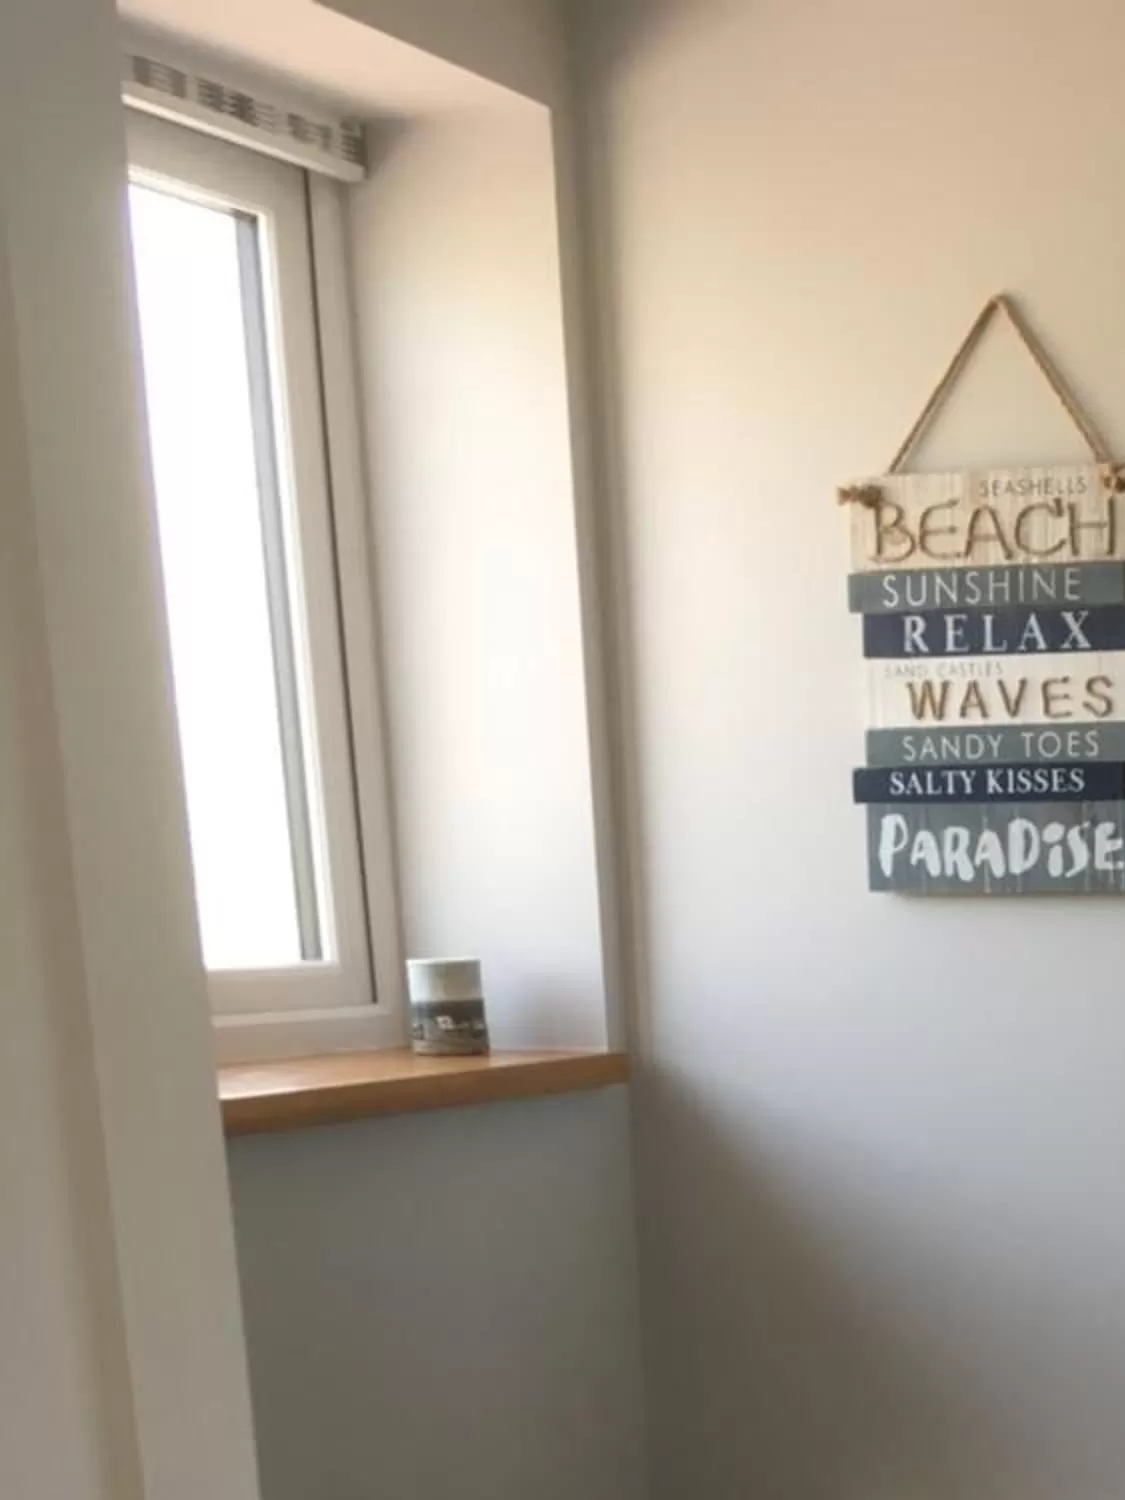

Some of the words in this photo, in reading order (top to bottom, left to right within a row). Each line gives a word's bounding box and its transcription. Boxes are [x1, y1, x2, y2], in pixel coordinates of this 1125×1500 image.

[979, 476, 1087, 496] SEASHELLS
[868, 496, 1117, 563] BEACH
[882, 568, 1083, 608] SUNSHINE
[903, 610, 1092, 653] RELAX
[906, 675, 1115, 720] WAVES
[902, 732, 1005, 761] SANDY
[1020, 730, 1100, 758] TOES
[889, 770, 977, 795] SALTY
[986, 767, 1086, 793] KISSES
